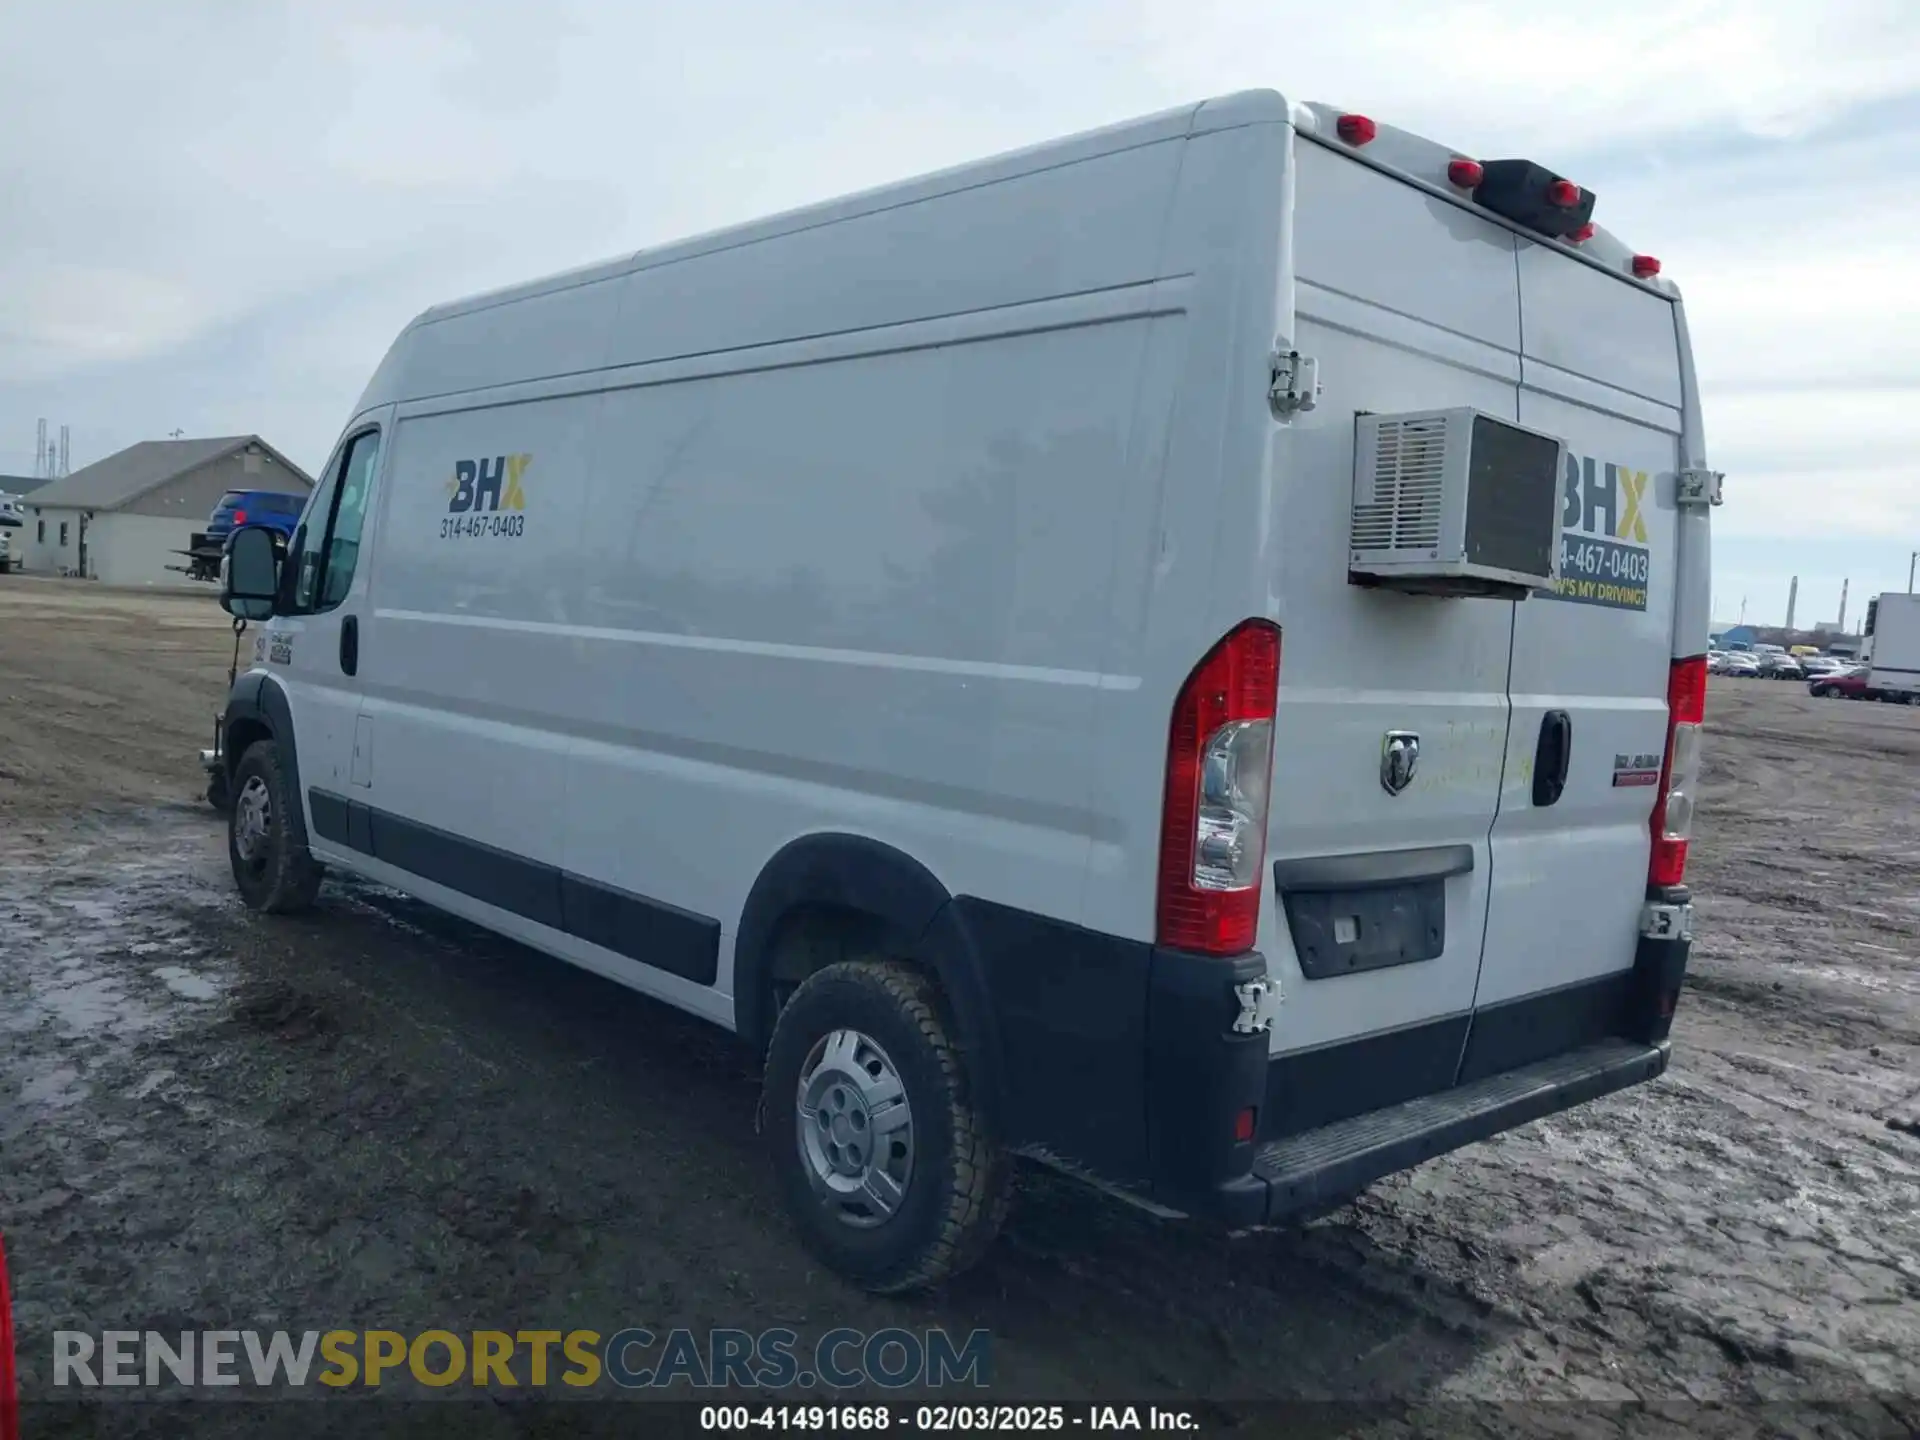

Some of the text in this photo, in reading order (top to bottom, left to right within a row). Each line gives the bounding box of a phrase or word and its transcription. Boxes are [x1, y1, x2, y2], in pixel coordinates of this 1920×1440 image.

[448, 453, 533, 513] BHX
[440, 515, 524, 539] 314-467-0403
[1578, 580, 1597, 598] MY
[1598, 582, 1646, 605] DRIVING?
